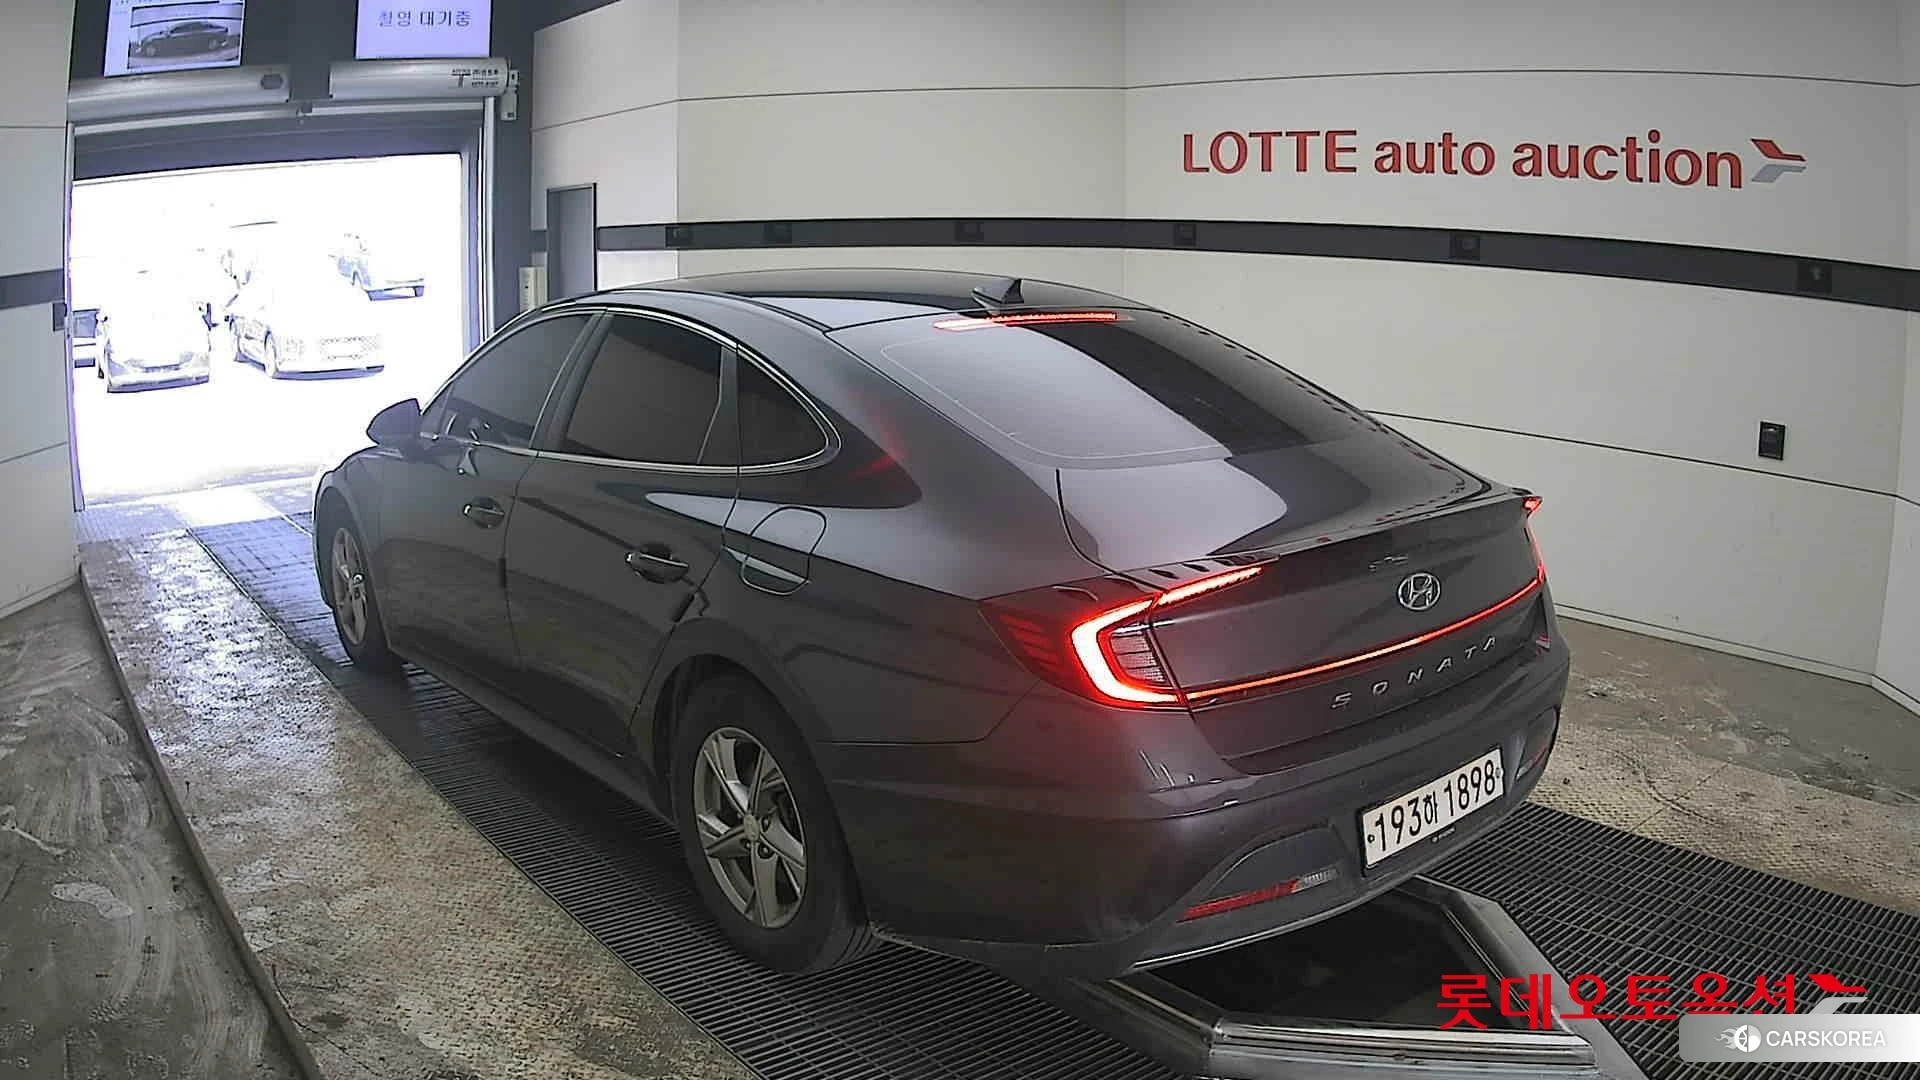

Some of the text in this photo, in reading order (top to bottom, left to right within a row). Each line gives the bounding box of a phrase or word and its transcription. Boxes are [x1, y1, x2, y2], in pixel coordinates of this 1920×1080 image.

[420, 10, 471, 27] 대기중
[1183, 129, 1743, 189] LOTTE auto auction
[1331, 635, 1498, 709] SONATA
[1375, 759, 1496, 852] 193하 1898
